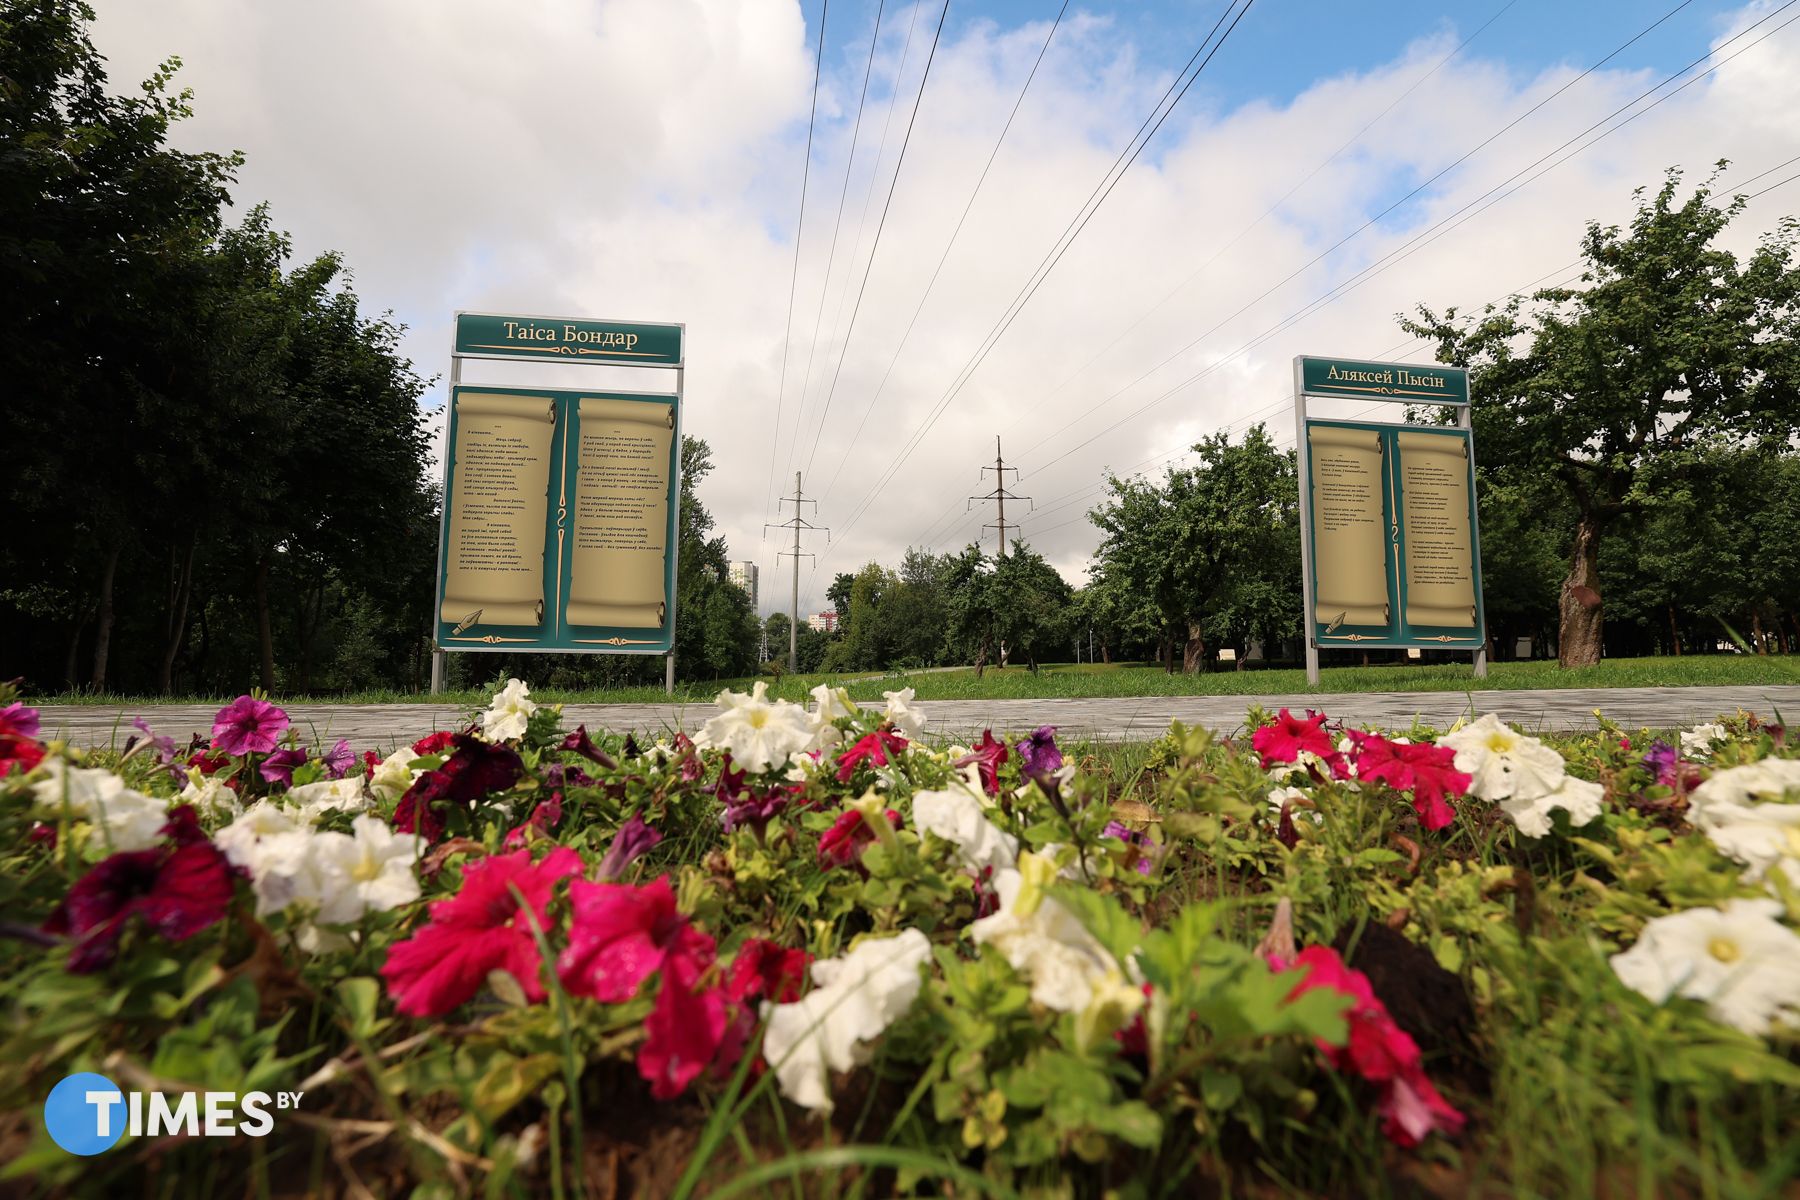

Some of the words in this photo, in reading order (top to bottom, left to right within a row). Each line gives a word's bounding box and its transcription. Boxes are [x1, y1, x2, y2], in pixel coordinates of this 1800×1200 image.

[503, 321, 557, 341] Таіса
[562, 324, 638, 351] Бондар
[1327, 364, 1393, 385] Аляксей
[1397, 370, 1445, 388] Пысін
